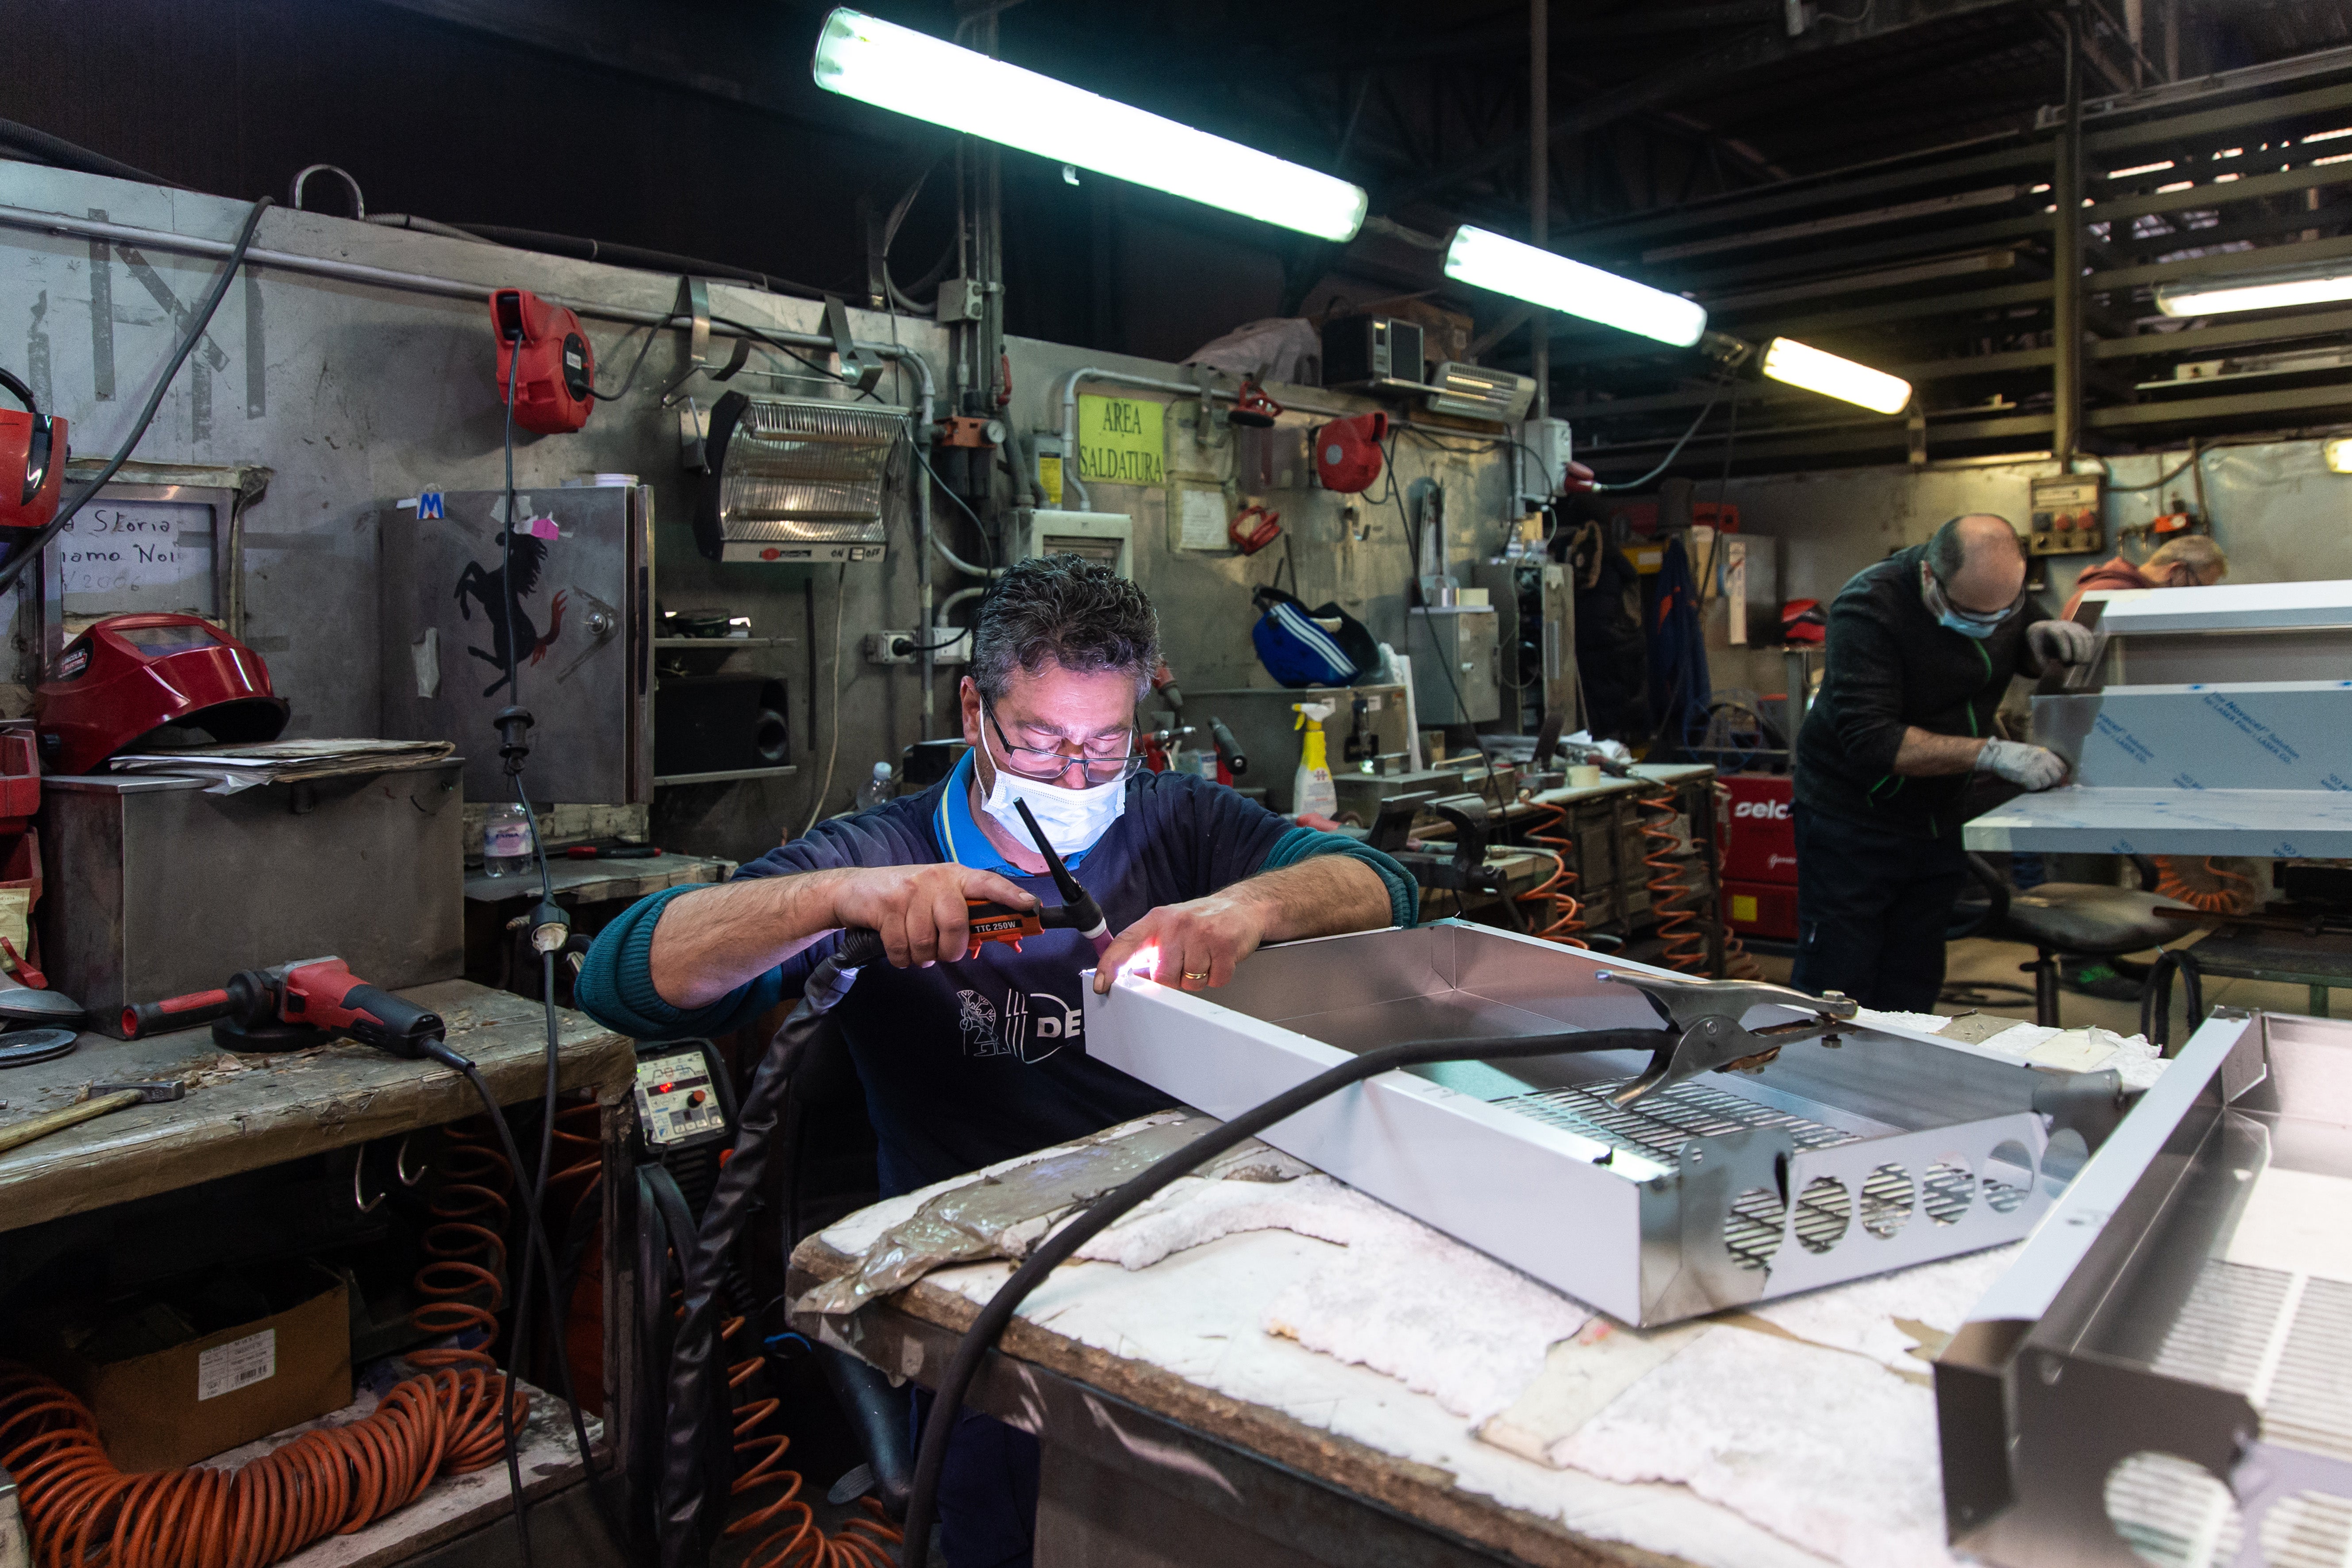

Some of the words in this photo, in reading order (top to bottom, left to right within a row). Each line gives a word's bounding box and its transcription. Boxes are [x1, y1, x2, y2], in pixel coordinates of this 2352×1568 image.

[1102, 402, 1142, 435] AREA
[1079, 445, 1163, 482] SALDATURA
[419, 493, 444, 519] M
[93, 509, 170, 533] Storia
[62, 551, 120, 562] iamo
[133, 543, 175, 563] Noi
[831, 548, 844, 558] ON
[866, 548, 881, 557] OFF
[1734, 799, 1793, 820] selc
[975, 924, 991, 933] TTC
[993, 921, 1016, 931] 250W
[1037, 1009, 1086, 1039] DE
